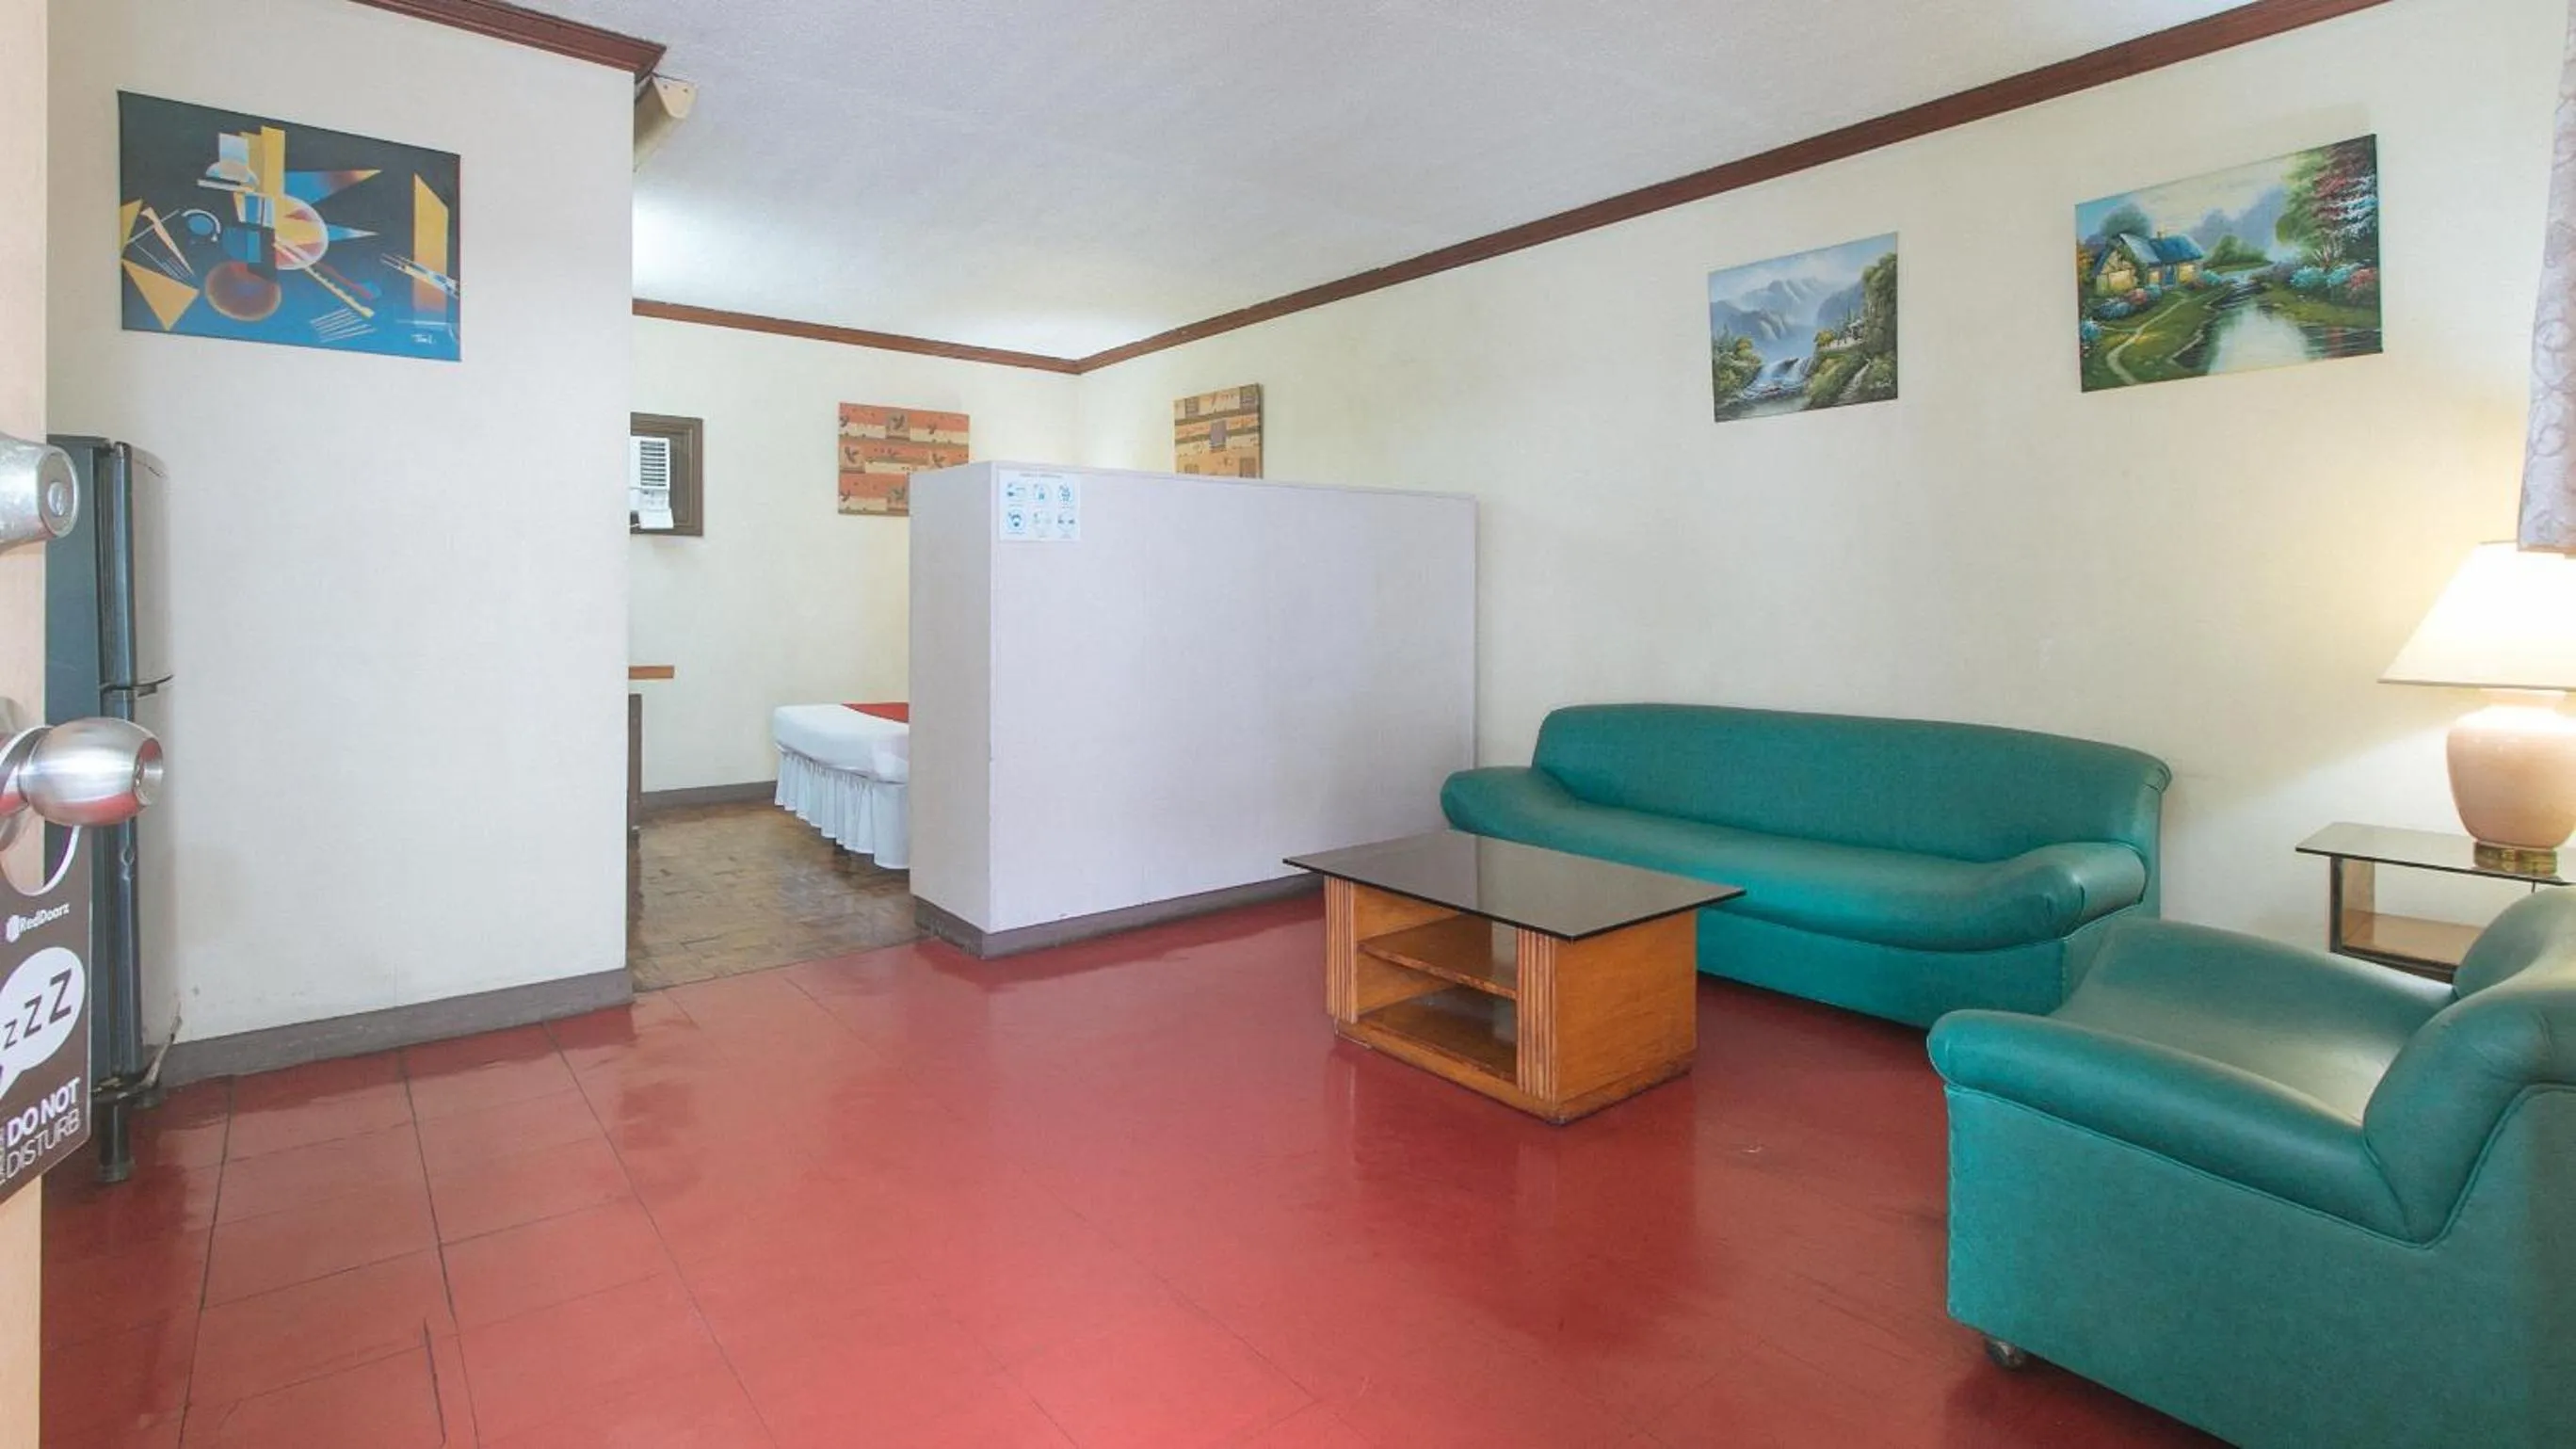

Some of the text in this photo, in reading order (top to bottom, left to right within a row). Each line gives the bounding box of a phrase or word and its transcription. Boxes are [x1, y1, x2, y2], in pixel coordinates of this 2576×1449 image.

[19, 903, 70, 931] RedDoorz
[7, 1108, 80, 1178] DISTURB
[8, 1077, 80, 1147] DO NOT
